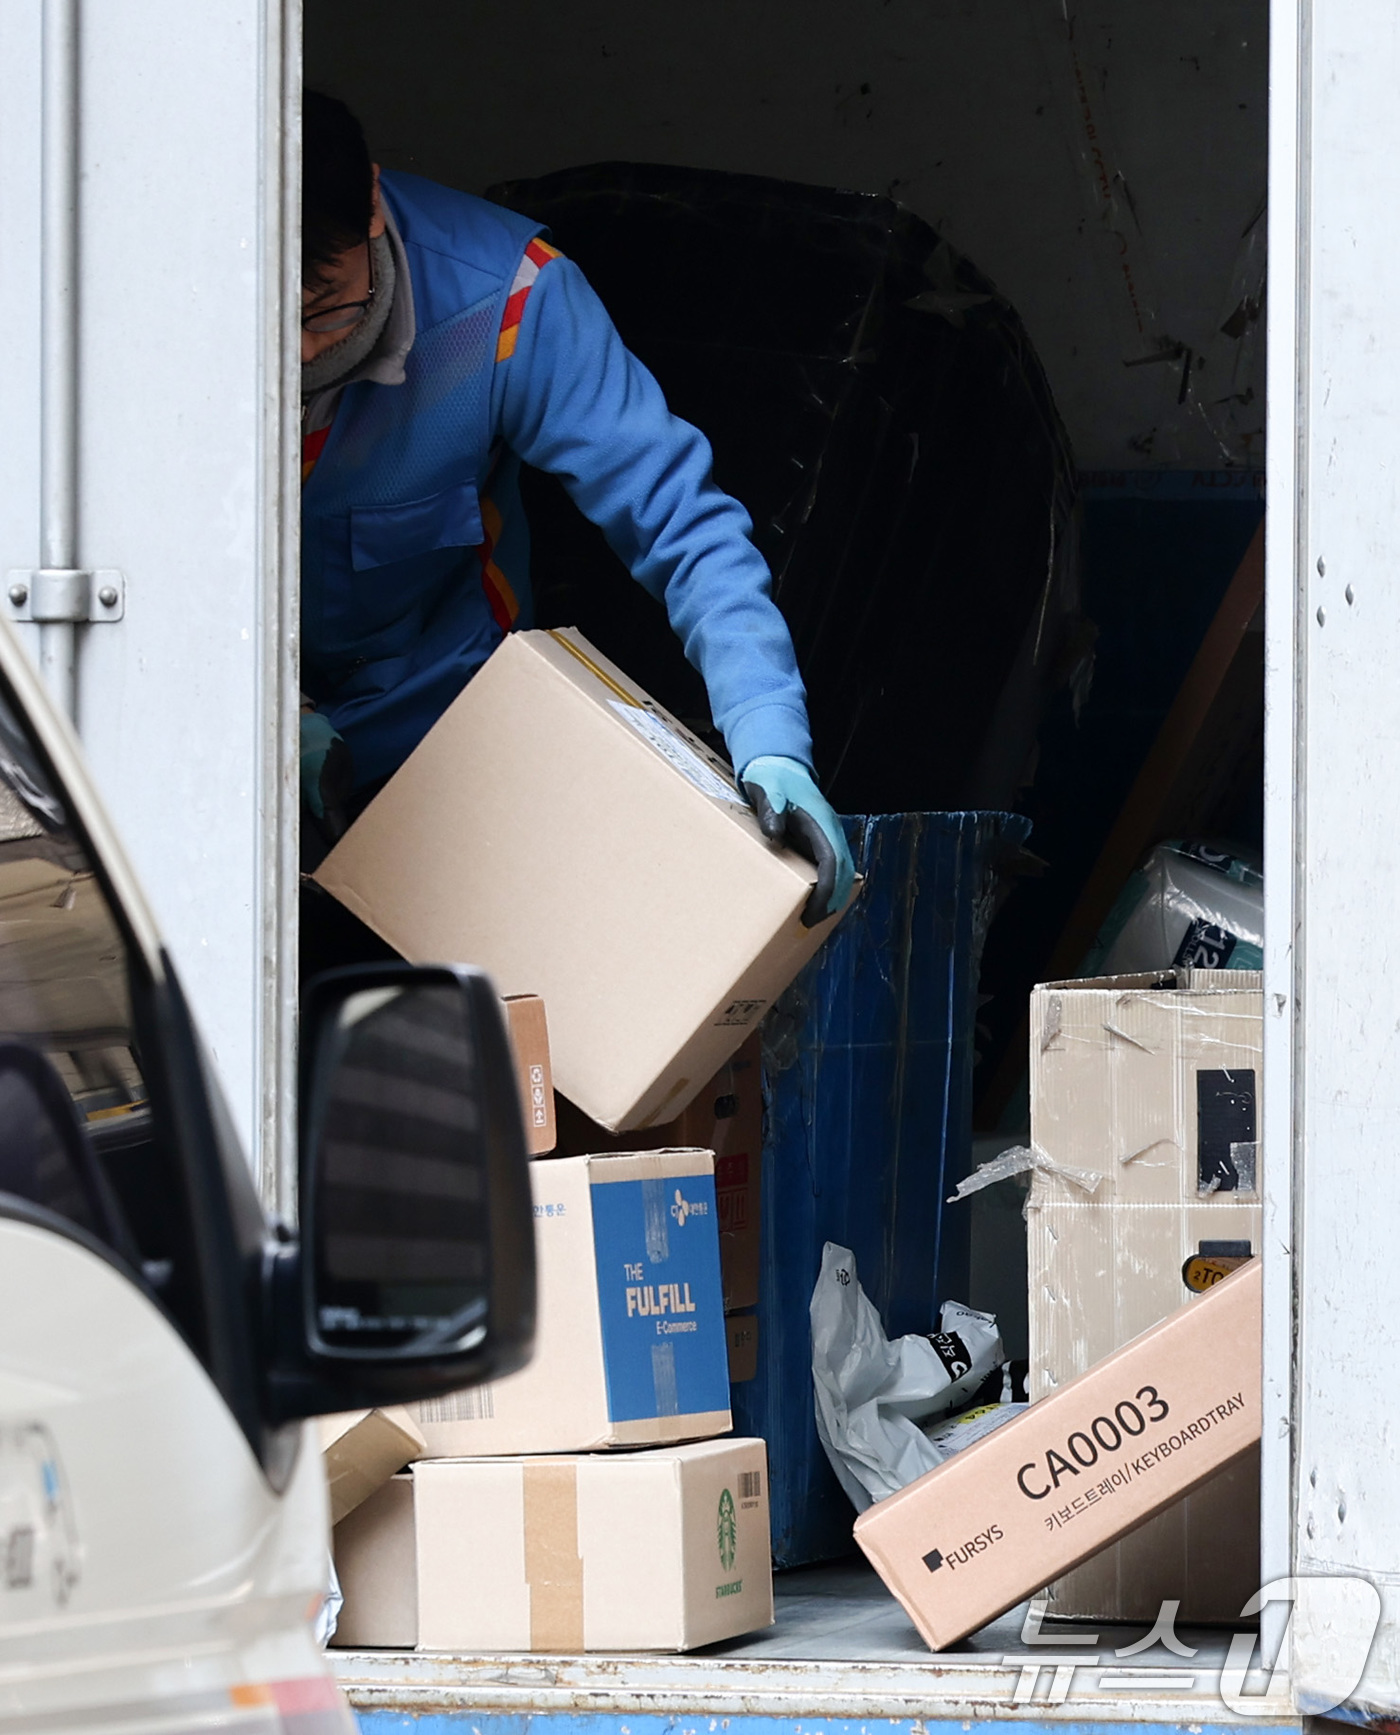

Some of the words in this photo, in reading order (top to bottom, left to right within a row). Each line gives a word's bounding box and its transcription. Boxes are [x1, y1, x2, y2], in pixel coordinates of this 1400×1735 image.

[1193, 933, 1226, 969] 12
[624, 1262, 645, 1282] THE
[626, 1282, 697, 1318] FULFILL
[656, 1320, 698, 1335] E-Commerce
[1017, 1385, 1169, 1500] CA0003
[945, 1524, 1004, 1571] FURSYS
